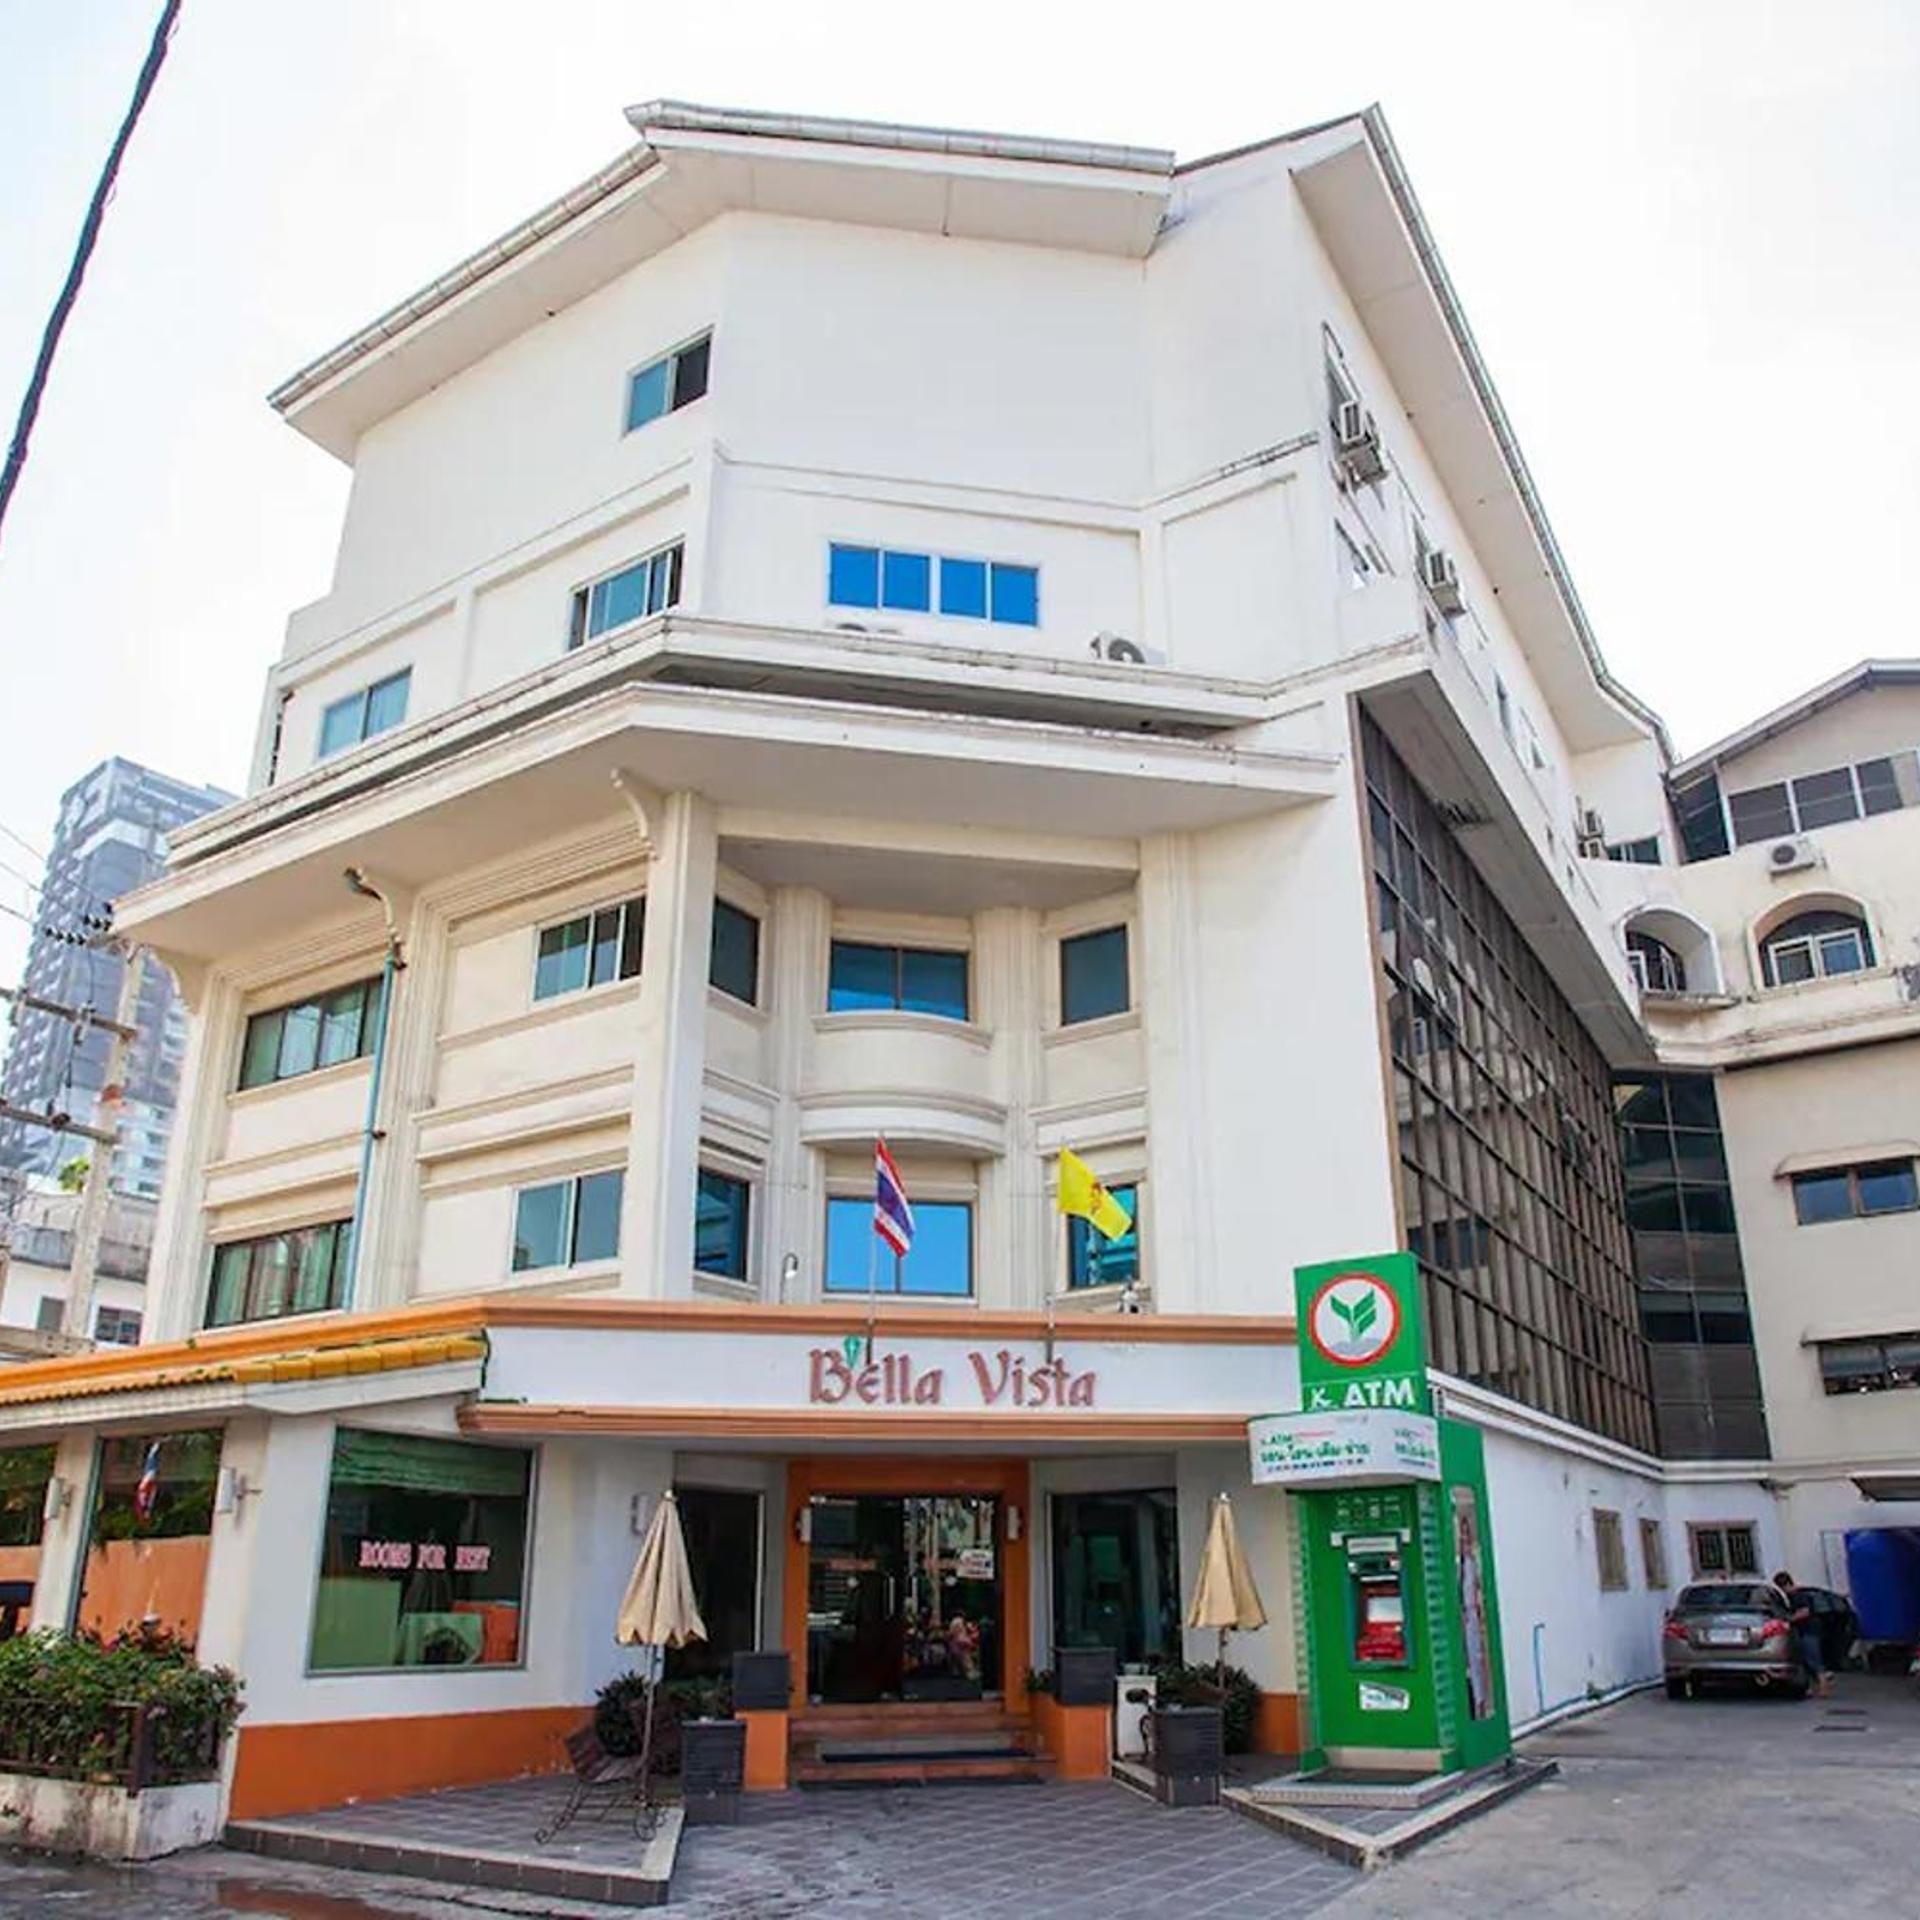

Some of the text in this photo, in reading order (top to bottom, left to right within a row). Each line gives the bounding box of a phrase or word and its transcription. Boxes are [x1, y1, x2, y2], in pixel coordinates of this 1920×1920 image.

[810, 1348, 1096, 1406] Bella Vista
[1343, 1377, 1416, 1406] ATM
[359, 1540, 412, 1569] ROOMS
[416, 1543, 446, 1570] FOR
